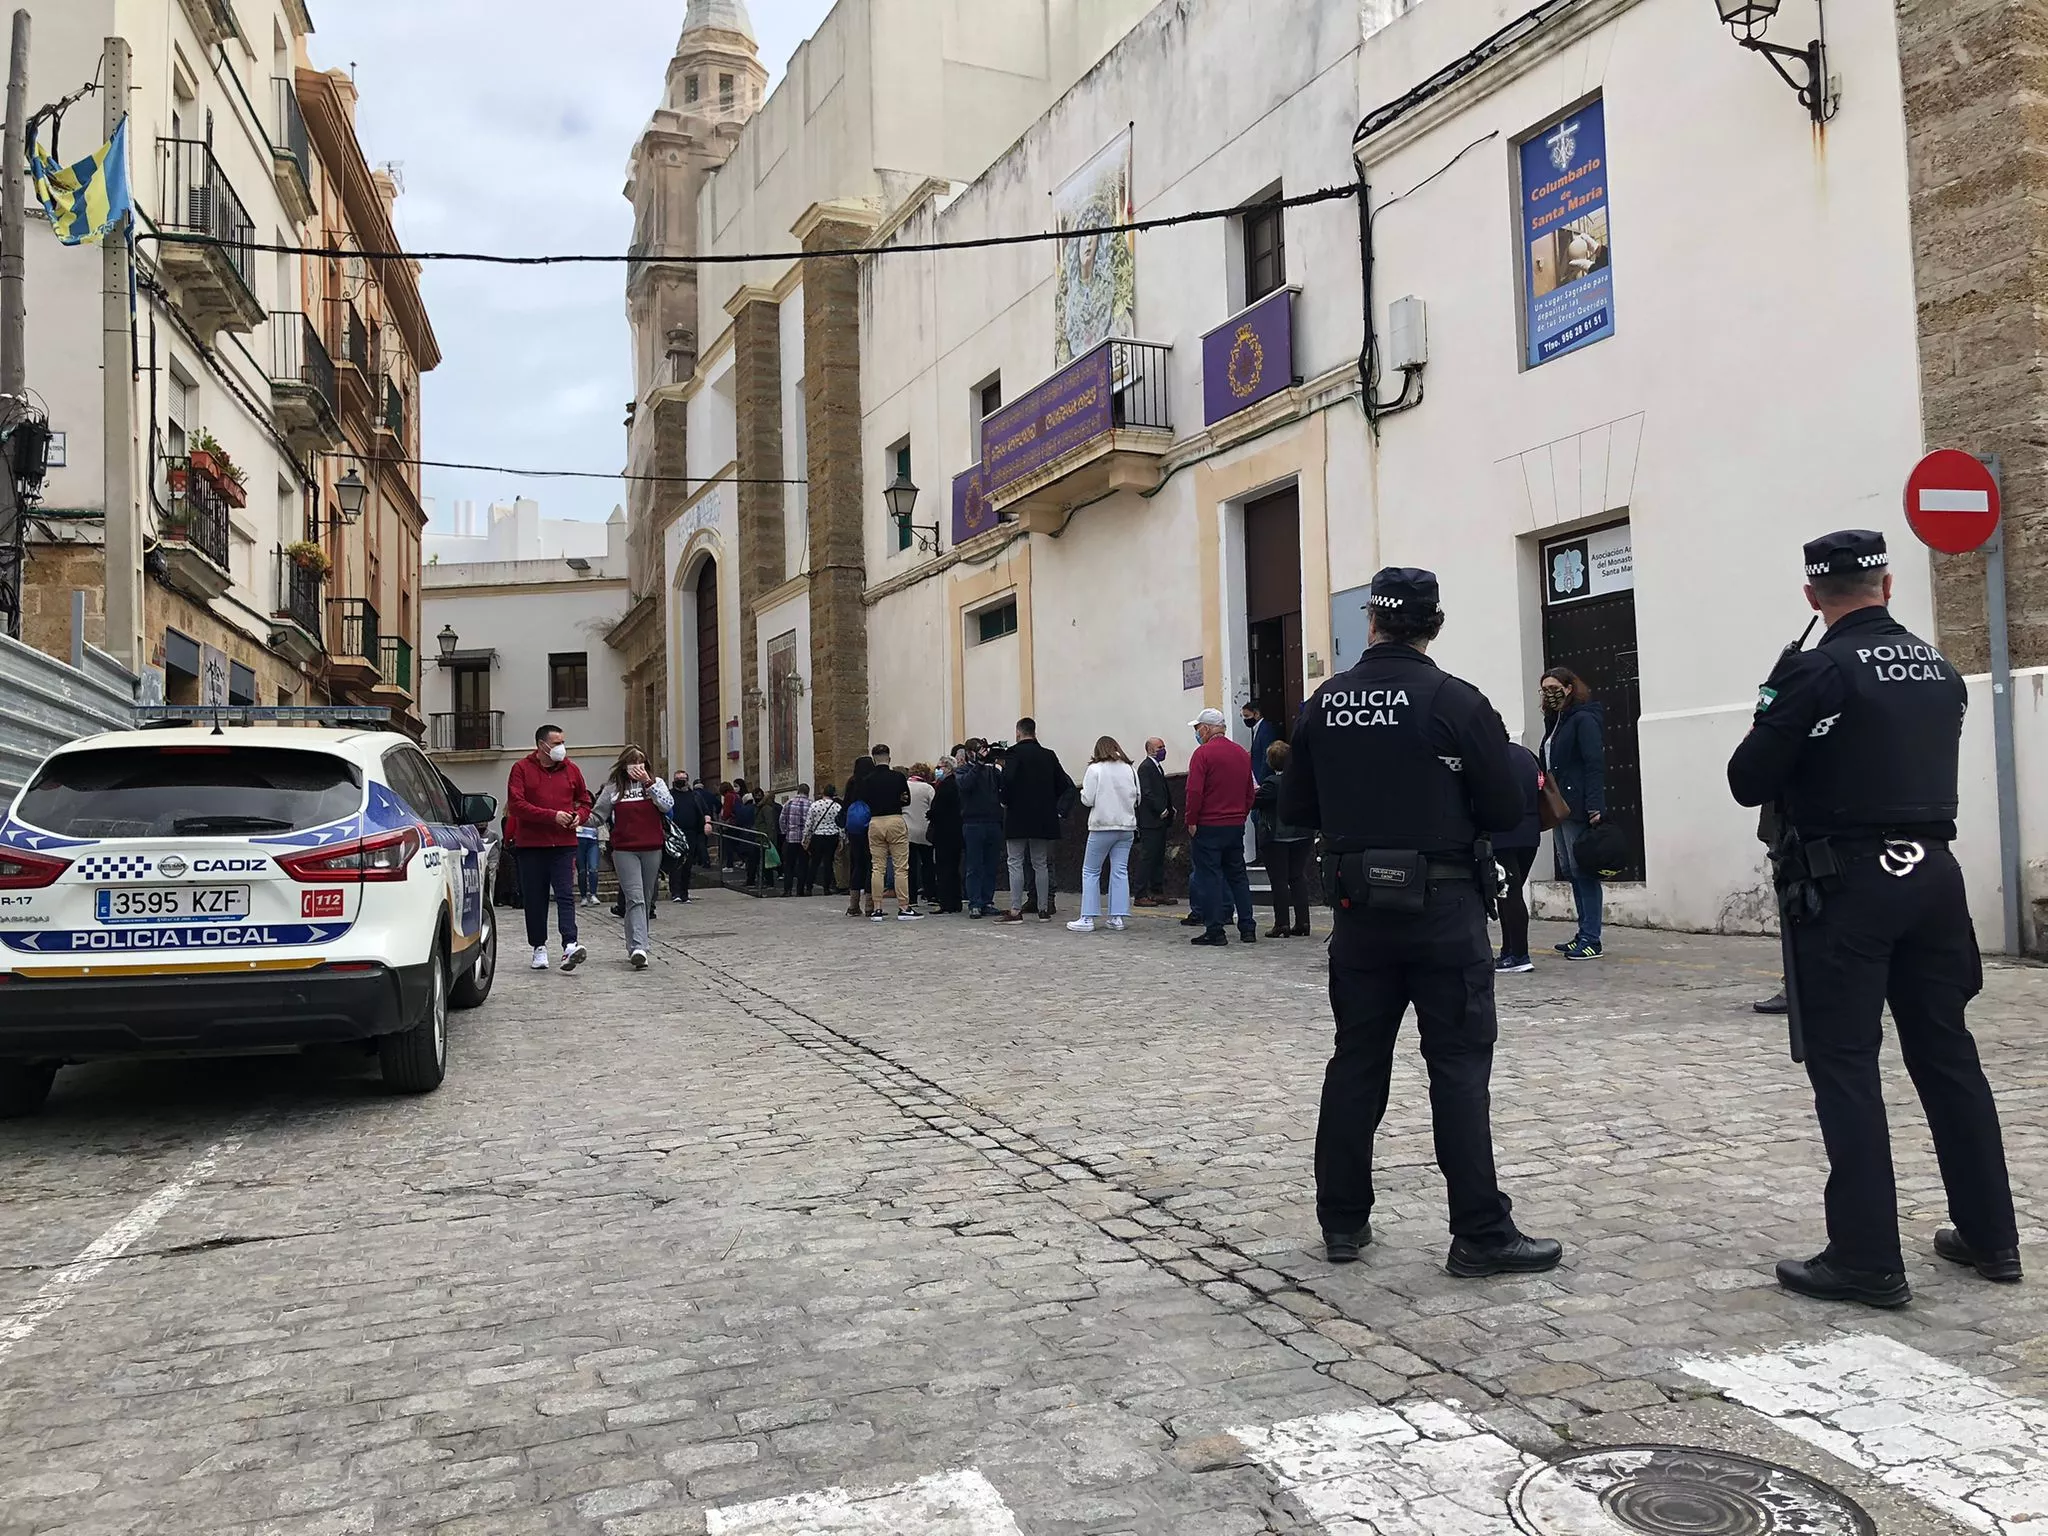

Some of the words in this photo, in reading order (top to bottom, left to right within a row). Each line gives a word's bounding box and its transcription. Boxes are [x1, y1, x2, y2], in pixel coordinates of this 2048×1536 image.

[1531, 158, 1601, 201] Columbario
[1560, 190, 1572, 201] de
[1531, 206, 1566, 230] Santa
[1534, 303, 1544, 312] Un
[1544, 294, 1564, 308] Lugar
[1564, 282, 1592, 299] Sagrado
[1592, 274, 1609, 289] para
[1558, 310, 1576, 324] Seres
[1577, 297, 1608, 315] Queridos
[1601, 567, 1620, 577] Santa
[1856, 644, 1945, 664] POLICIA
[1875, 664, 1947, 681] LOCAL
[1321, 690, 1410, 708] POLICIA
[1326, 709, 1399, 726] LOCAL
[193, 859, 267, 872] CADIZ
[1, 896, 33, 906] R-17
[115, 892, 179, 915] 3595
[192, 890, 240, 913] KZF
[316, 894, 342, 906] 112
[71, 929, 181, 949] POLICIA
[187, 927, 278, 945] LOCAL
